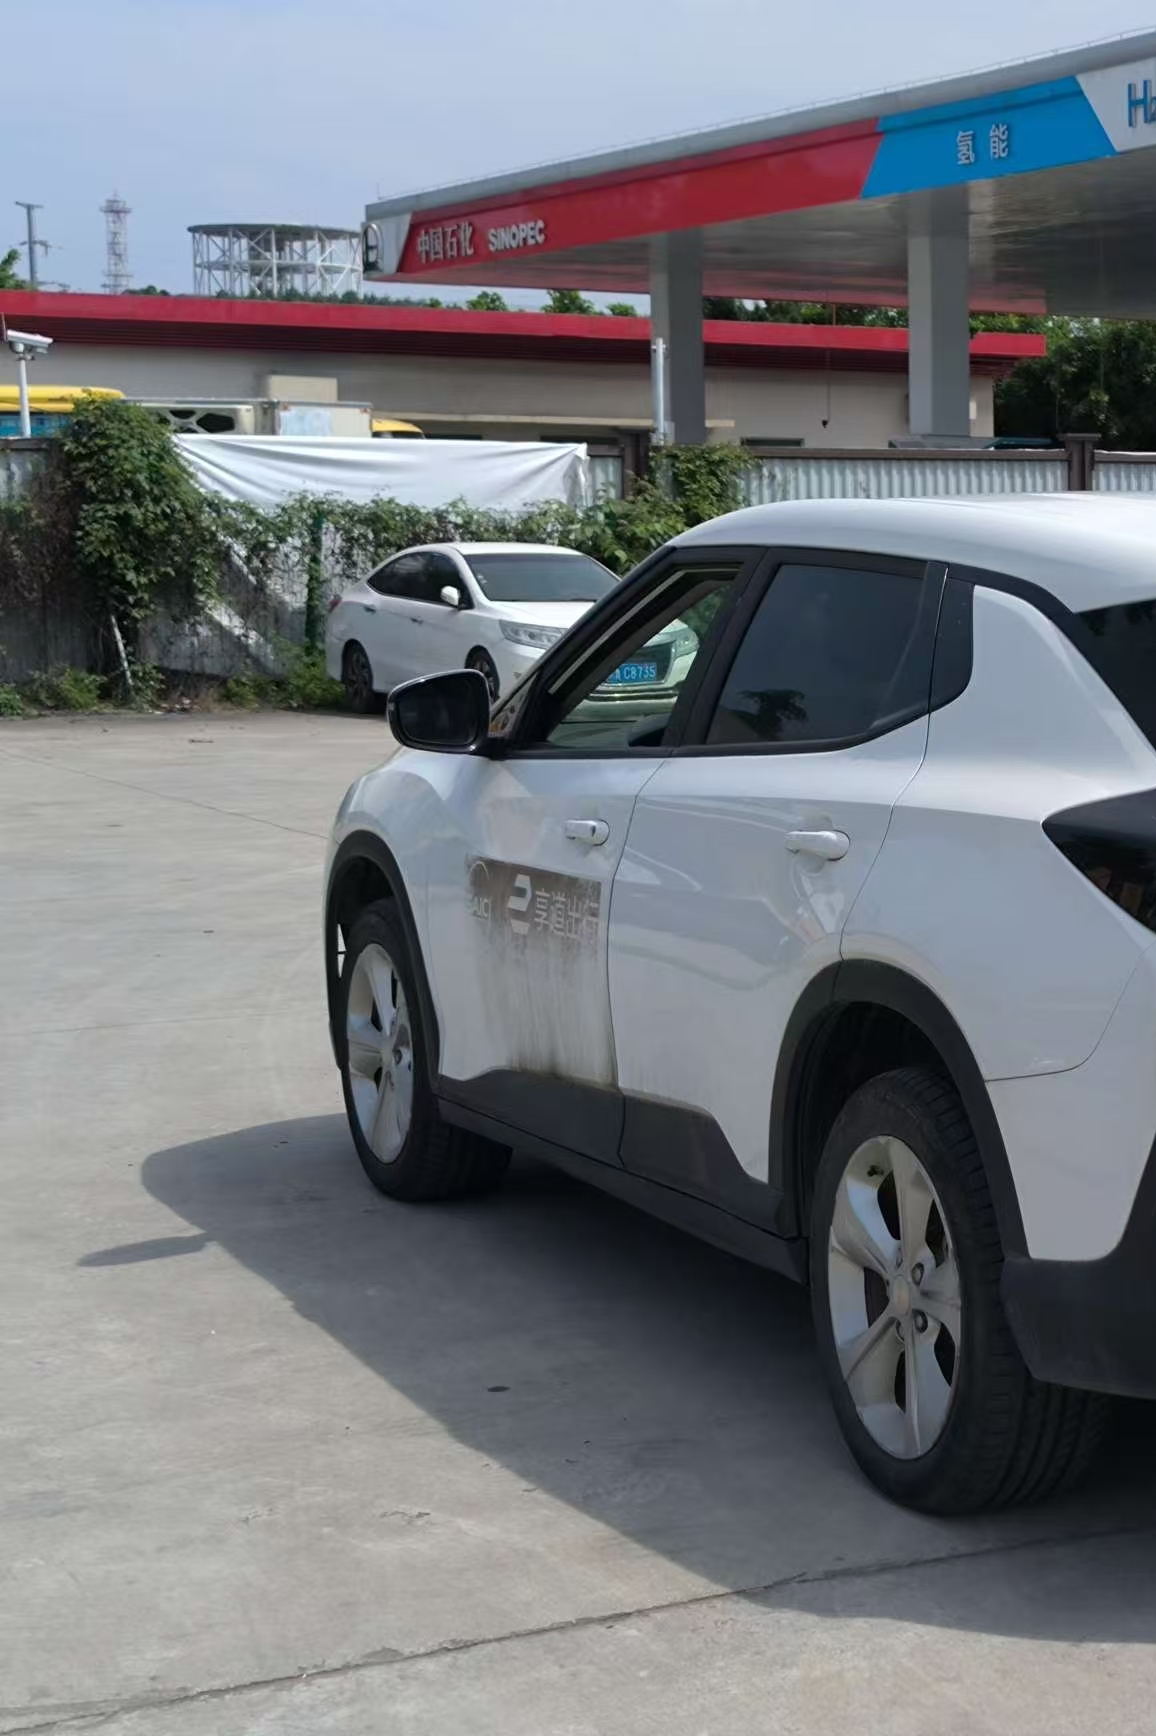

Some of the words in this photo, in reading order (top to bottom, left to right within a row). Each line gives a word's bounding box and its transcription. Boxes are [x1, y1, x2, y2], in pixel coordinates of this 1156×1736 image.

[957, 123, 1008, 165] 氢能
[417, 221, 474, 264] 中国石化
[488, 220, 545, 251] SINOPEC
